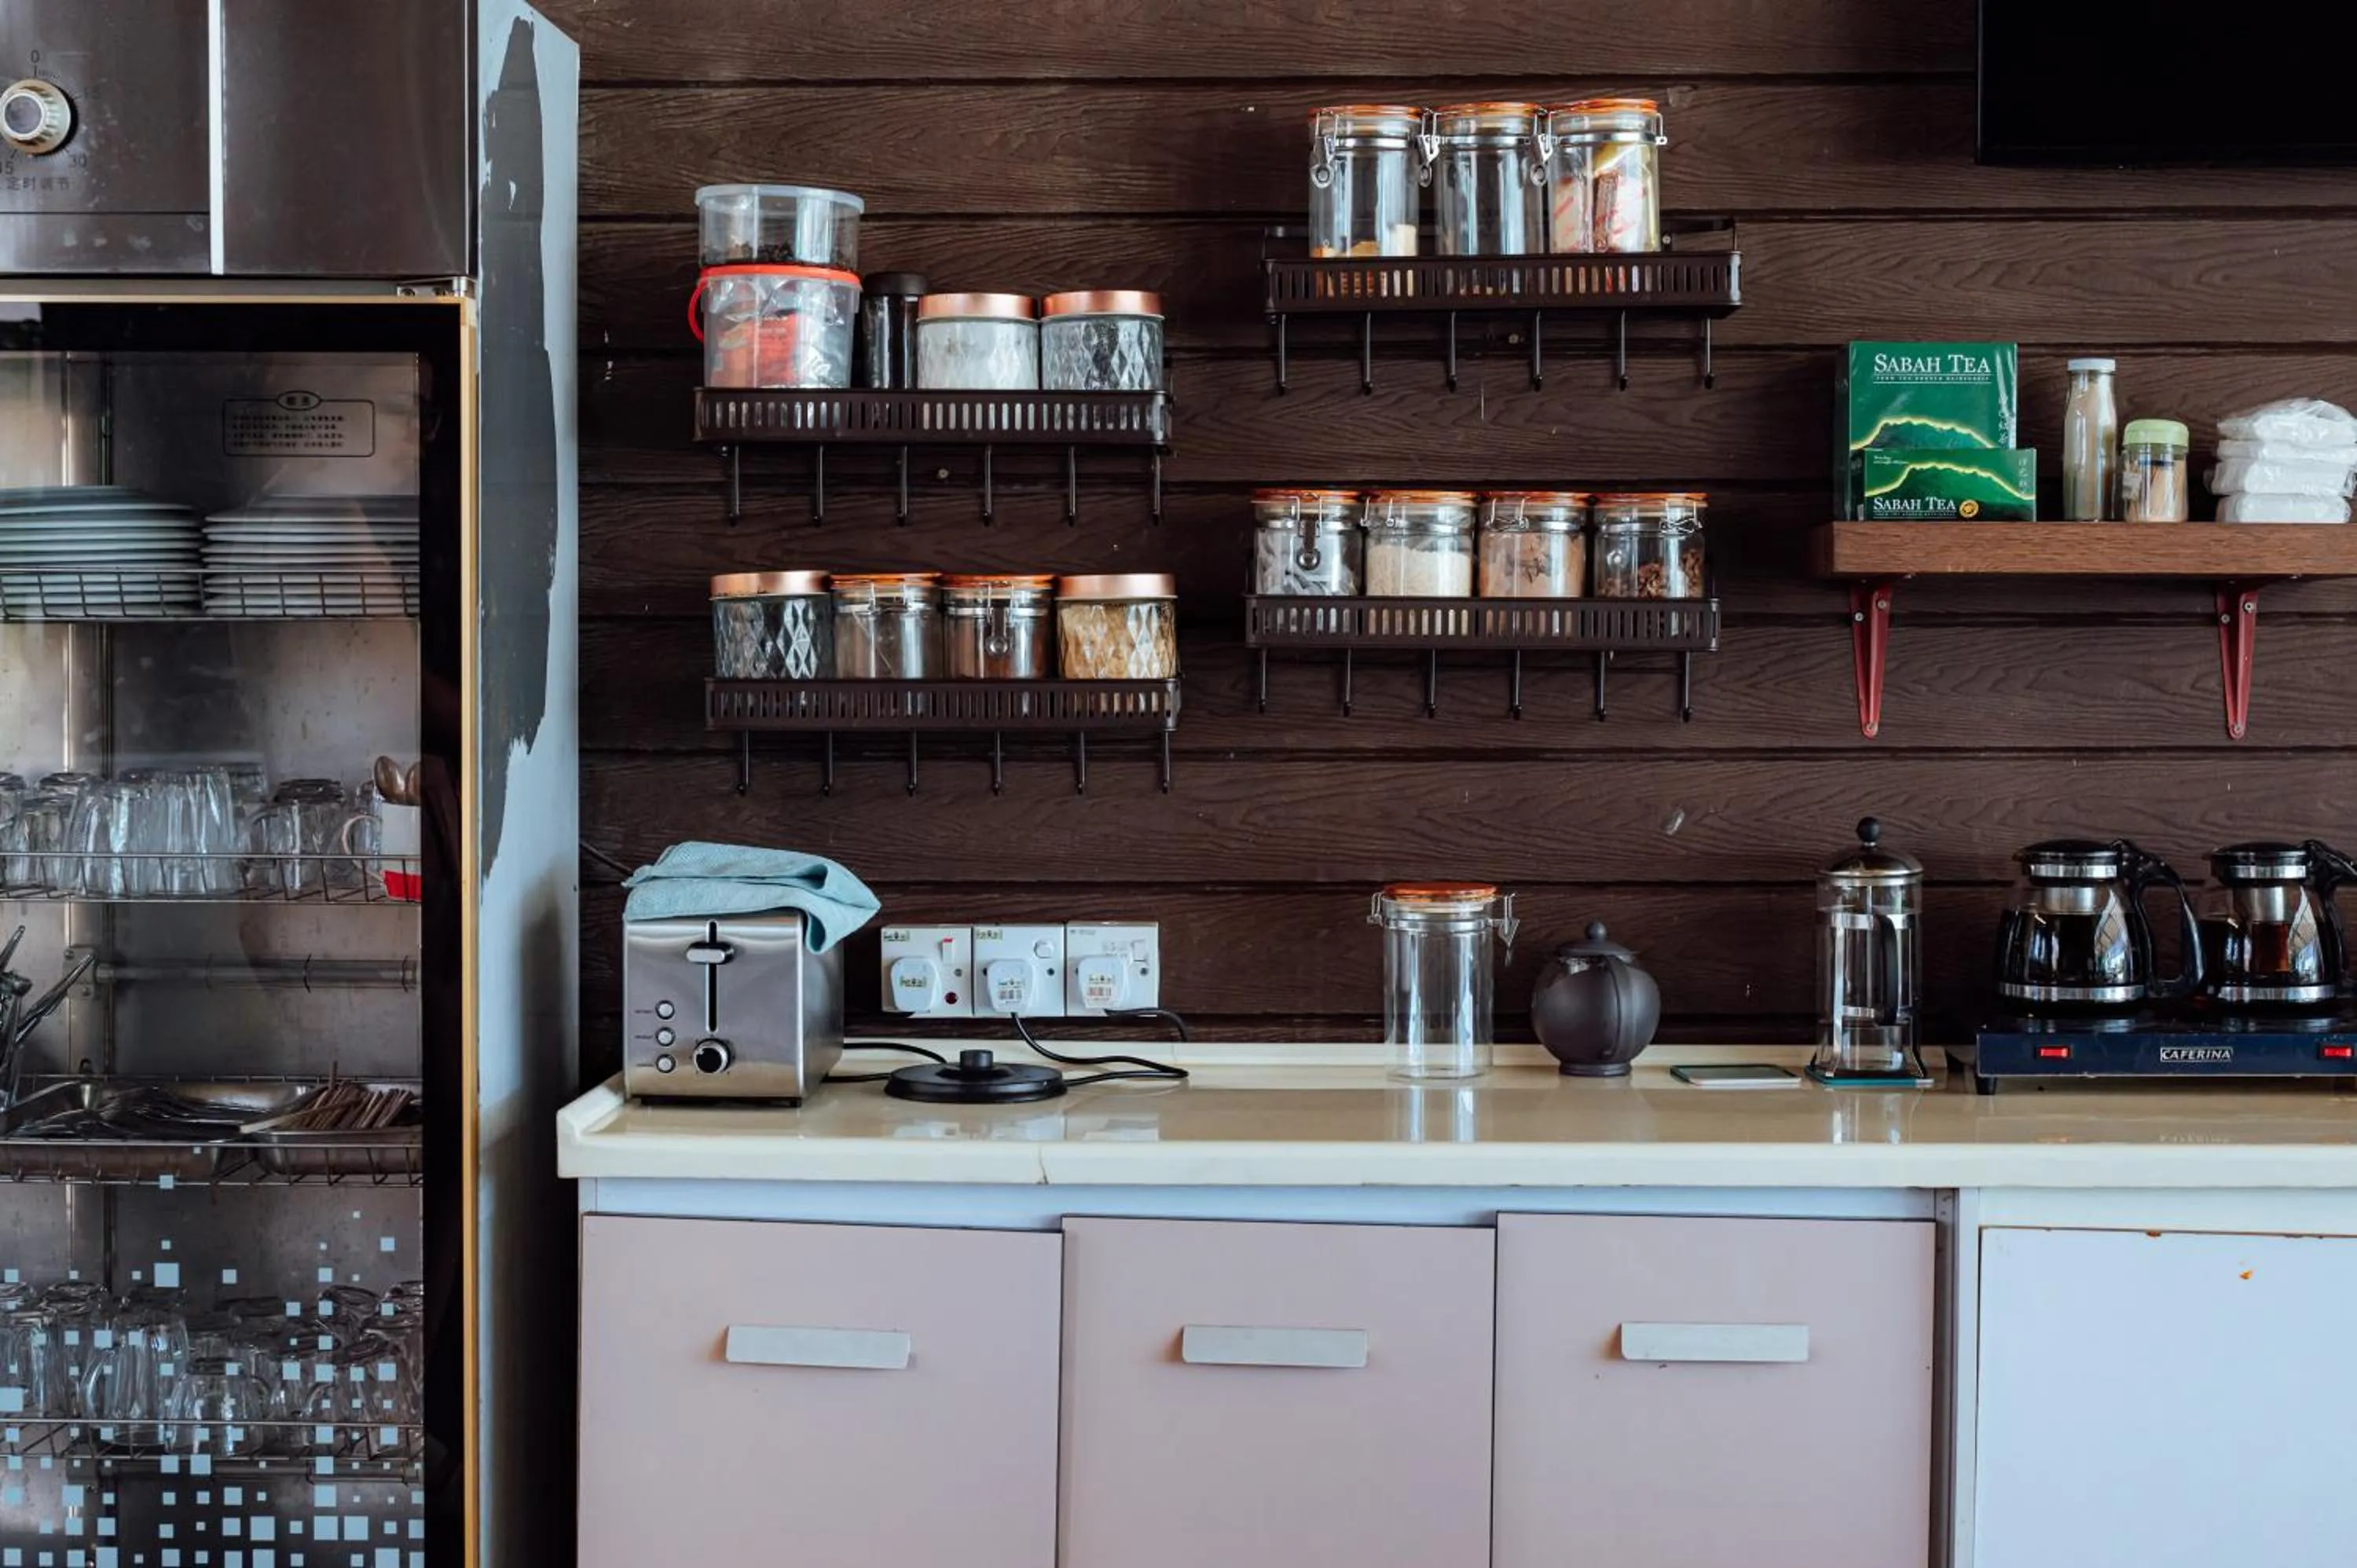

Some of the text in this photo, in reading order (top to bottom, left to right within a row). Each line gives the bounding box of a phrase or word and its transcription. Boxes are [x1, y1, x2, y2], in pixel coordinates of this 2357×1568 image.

[31, 49, 40, 64] 0
[1874, 353, 1991, 373] SABAH TEA
[1873, 496, 1956, 511] SABAH TEA
